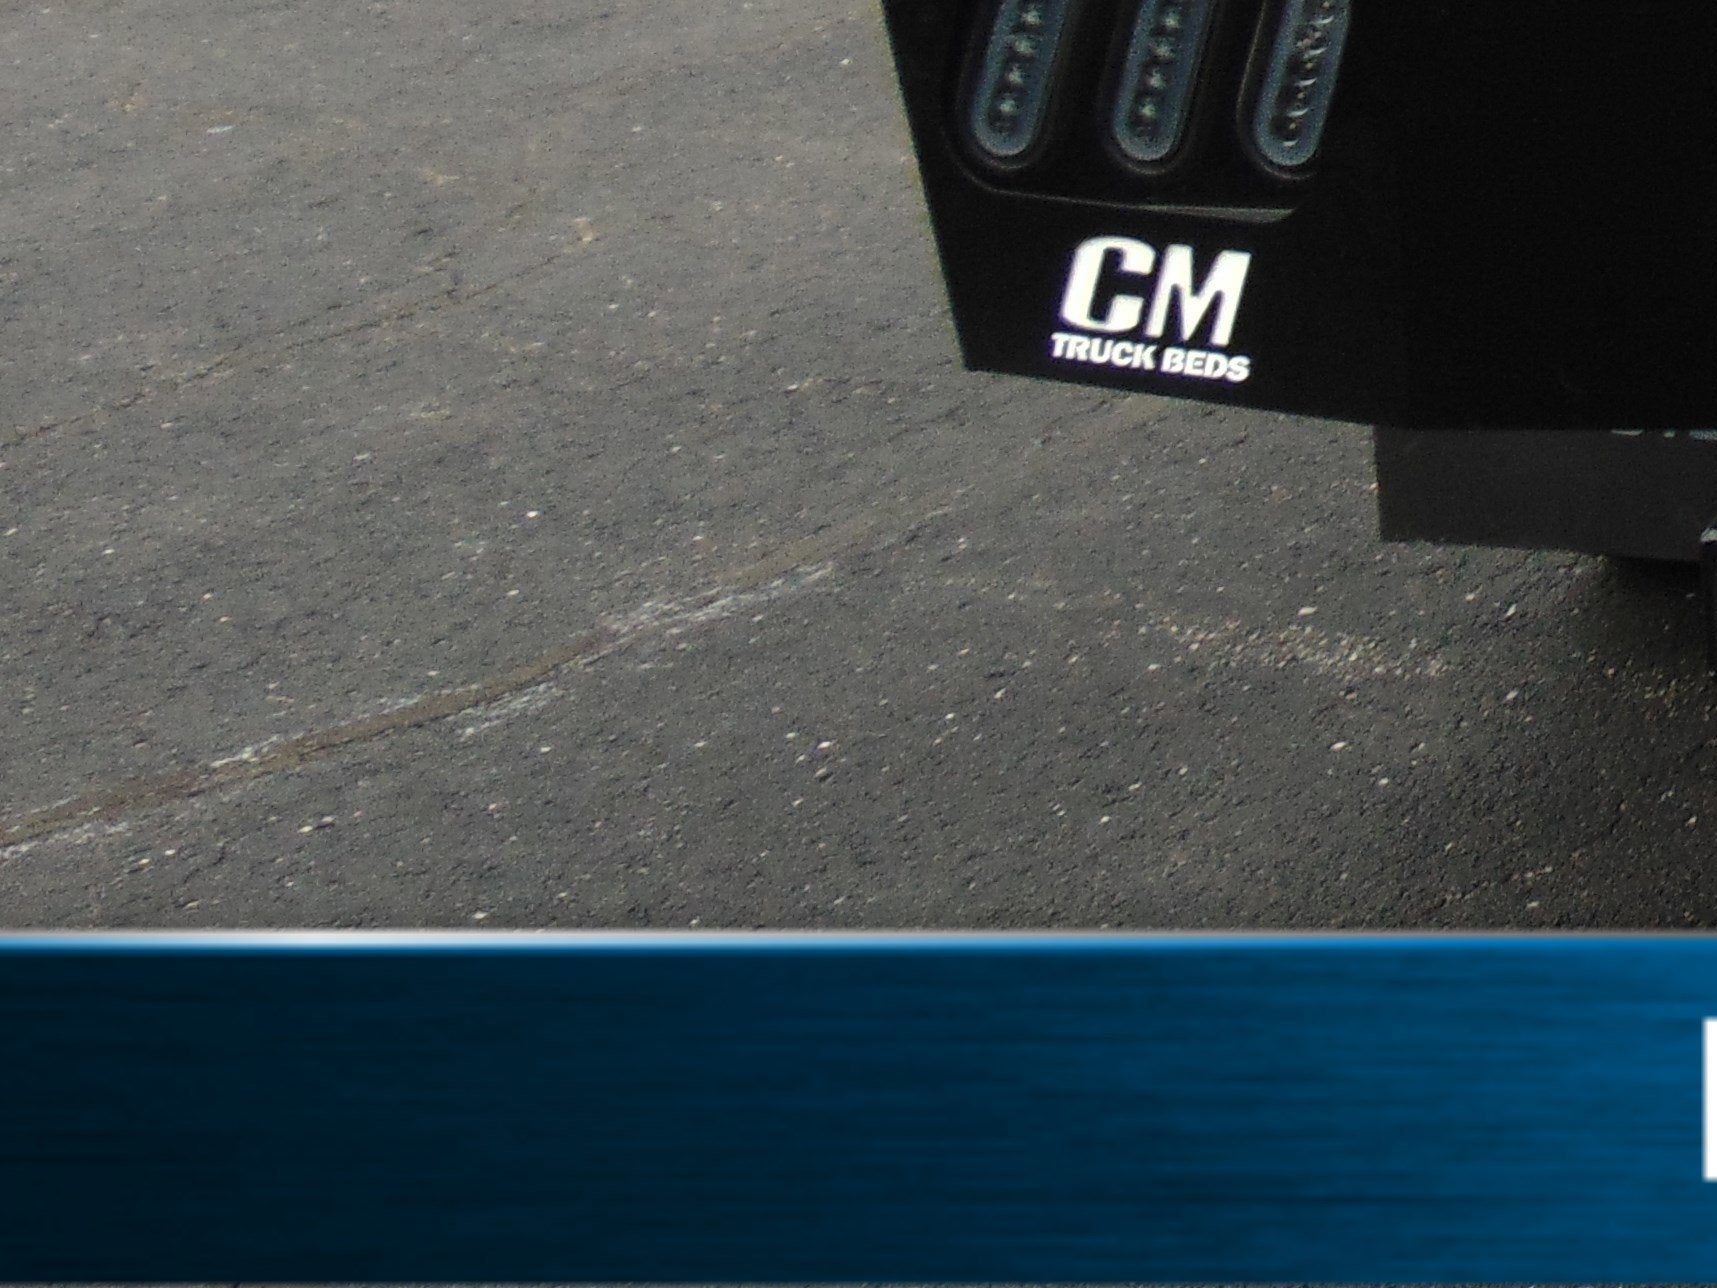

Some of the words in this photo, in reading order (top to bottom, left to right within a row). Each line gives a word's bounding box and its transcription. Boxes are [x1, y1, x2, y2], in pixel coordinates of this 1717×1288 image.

[1060, 234, 1253, 349] CM
[1051, 330, 1158, 371] TRUCK
[1161, 345, 1252, 384] BEDS
